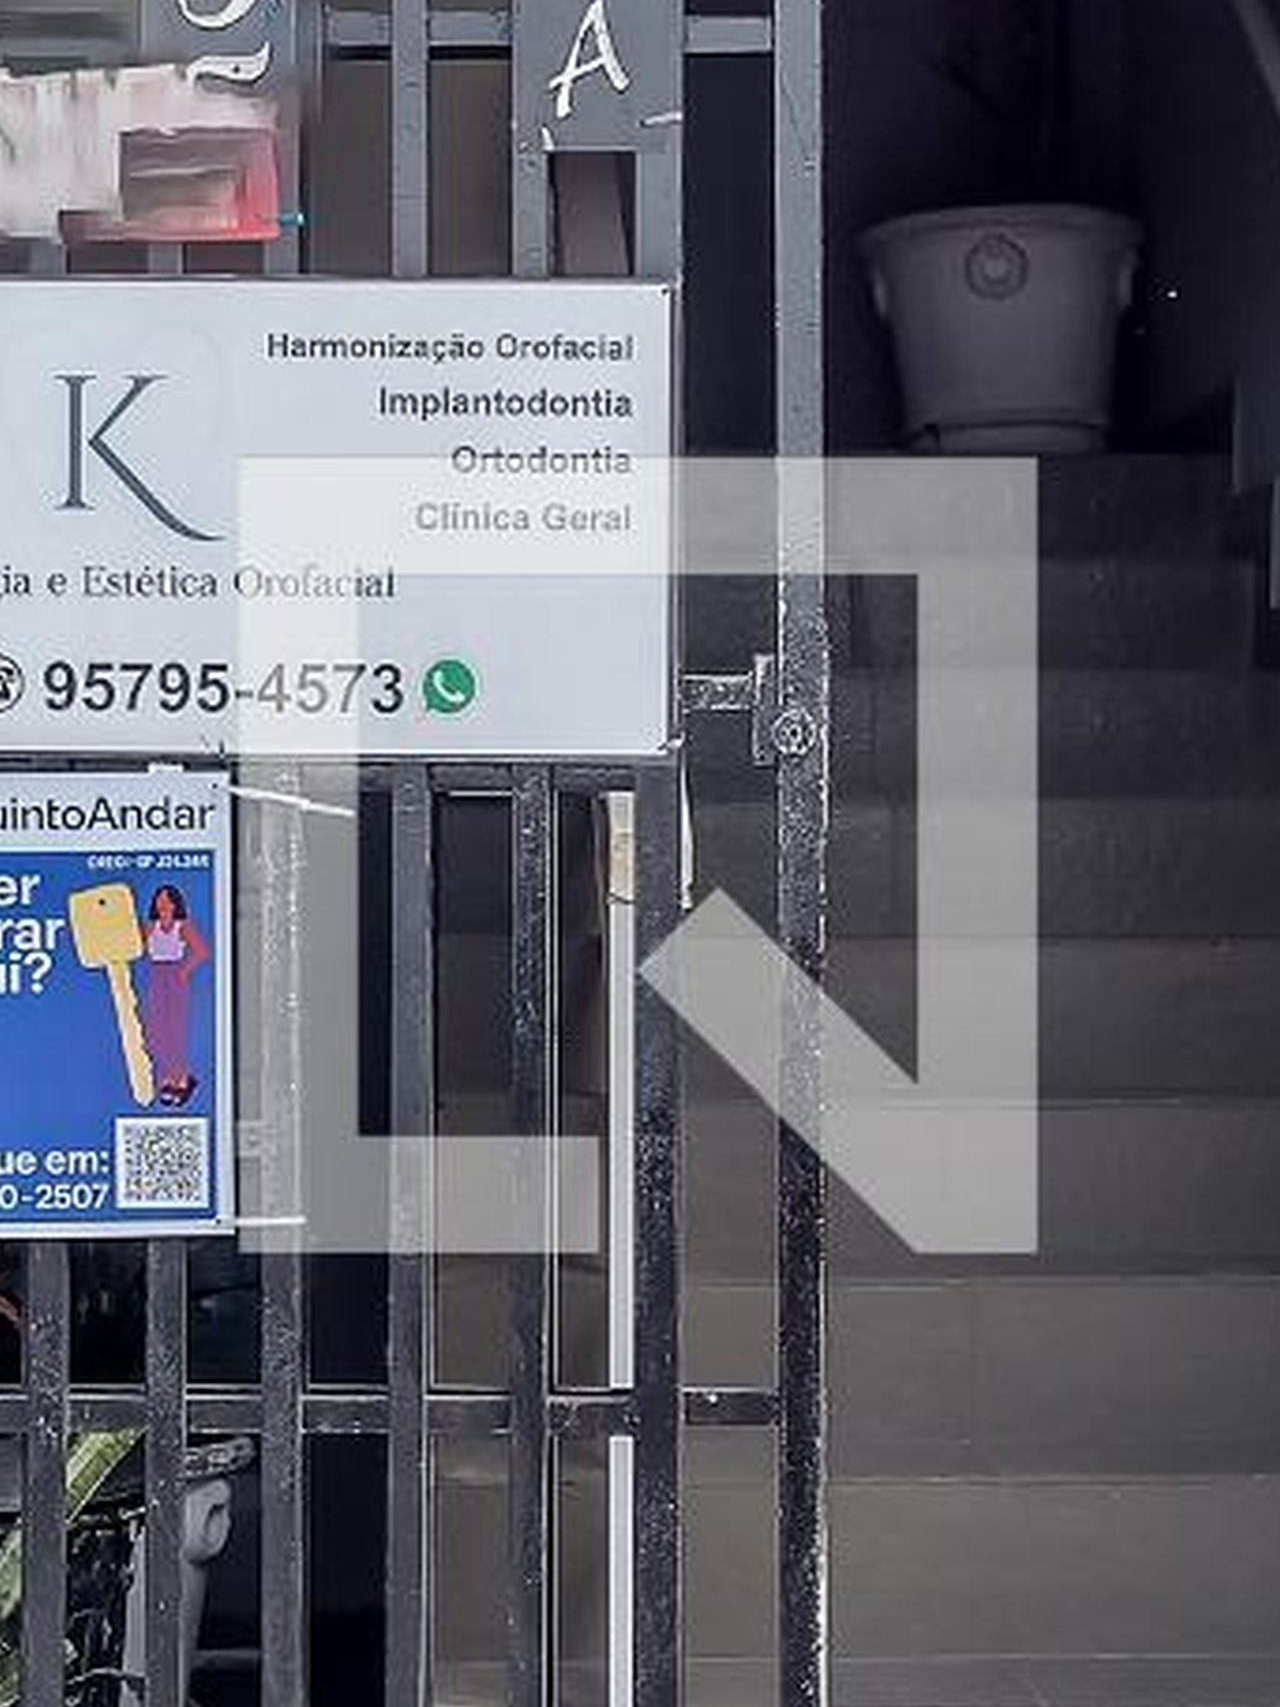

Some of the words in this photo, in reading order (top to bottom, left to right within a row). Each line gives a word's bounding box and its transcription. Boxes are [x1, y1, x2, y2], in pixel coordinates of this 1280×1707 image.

[266, 333, 485, 364] Harmonização
[495, 333, 634, 360] Orofacial
[379, 387, 633, 420] Implantodontia
[54, 374, 226, 542] K
[451, 445, 632, 475] Ortodontia
[416, 501, 531, 532] Clínica
[541, 502, 632, 532] Geral
[46, 572, 68, 597] e
[82, 562, 218, 598] Estética
[232, 562, 396, 599] Orofacial
[42, 661, 406, 715] 95795-4573
[45, 1150, 110, 1176] em:
